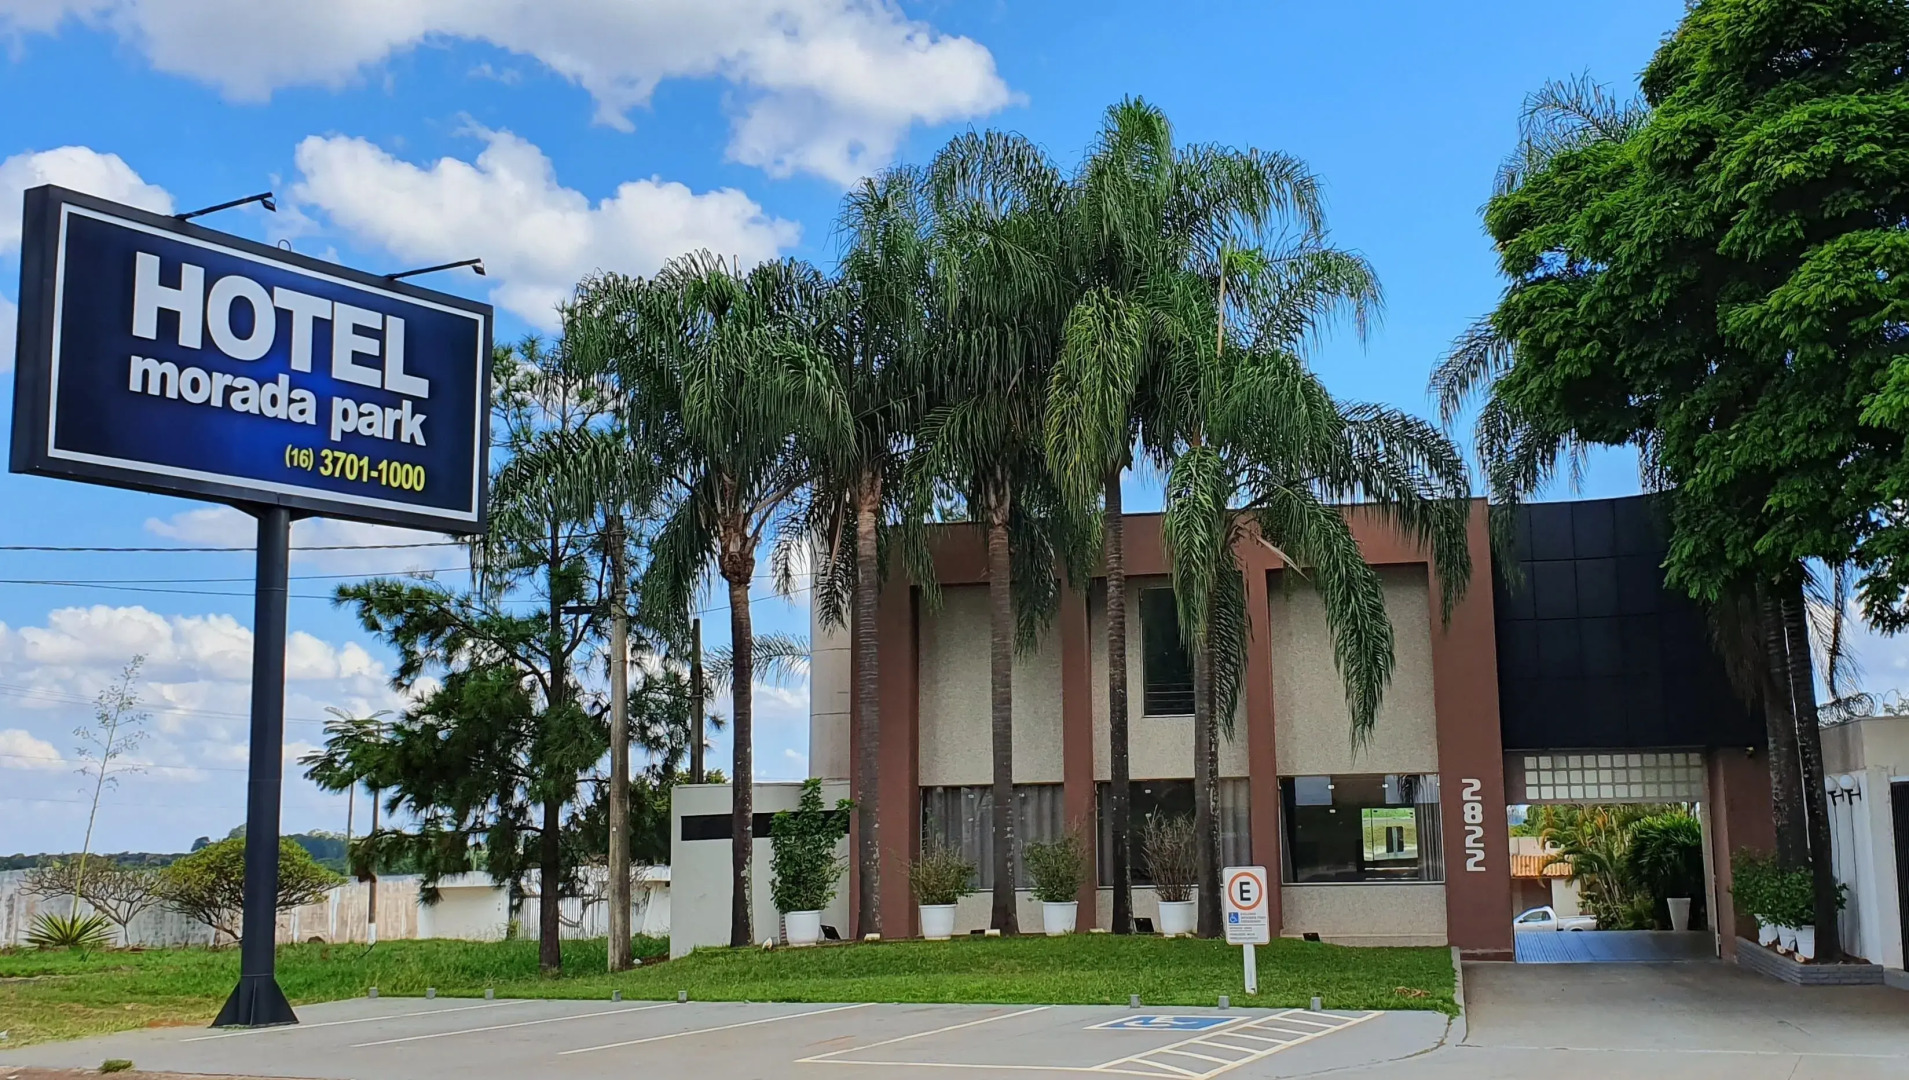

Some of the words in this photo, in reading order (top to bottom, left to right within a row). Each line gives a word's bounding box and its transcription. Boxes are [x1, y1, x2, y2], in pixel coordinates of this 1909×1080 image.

[134, 251, 429, 399] HOTEL
[129, 355, 317, 426] morada
[330, 398, 428, 446] park
[285, 444, 315, 472] (16)
[319, 448, 427, 492] 3701-1000
[1461, 778, 1486, 872] 2822
[1239, 881, 1252, 902] E
